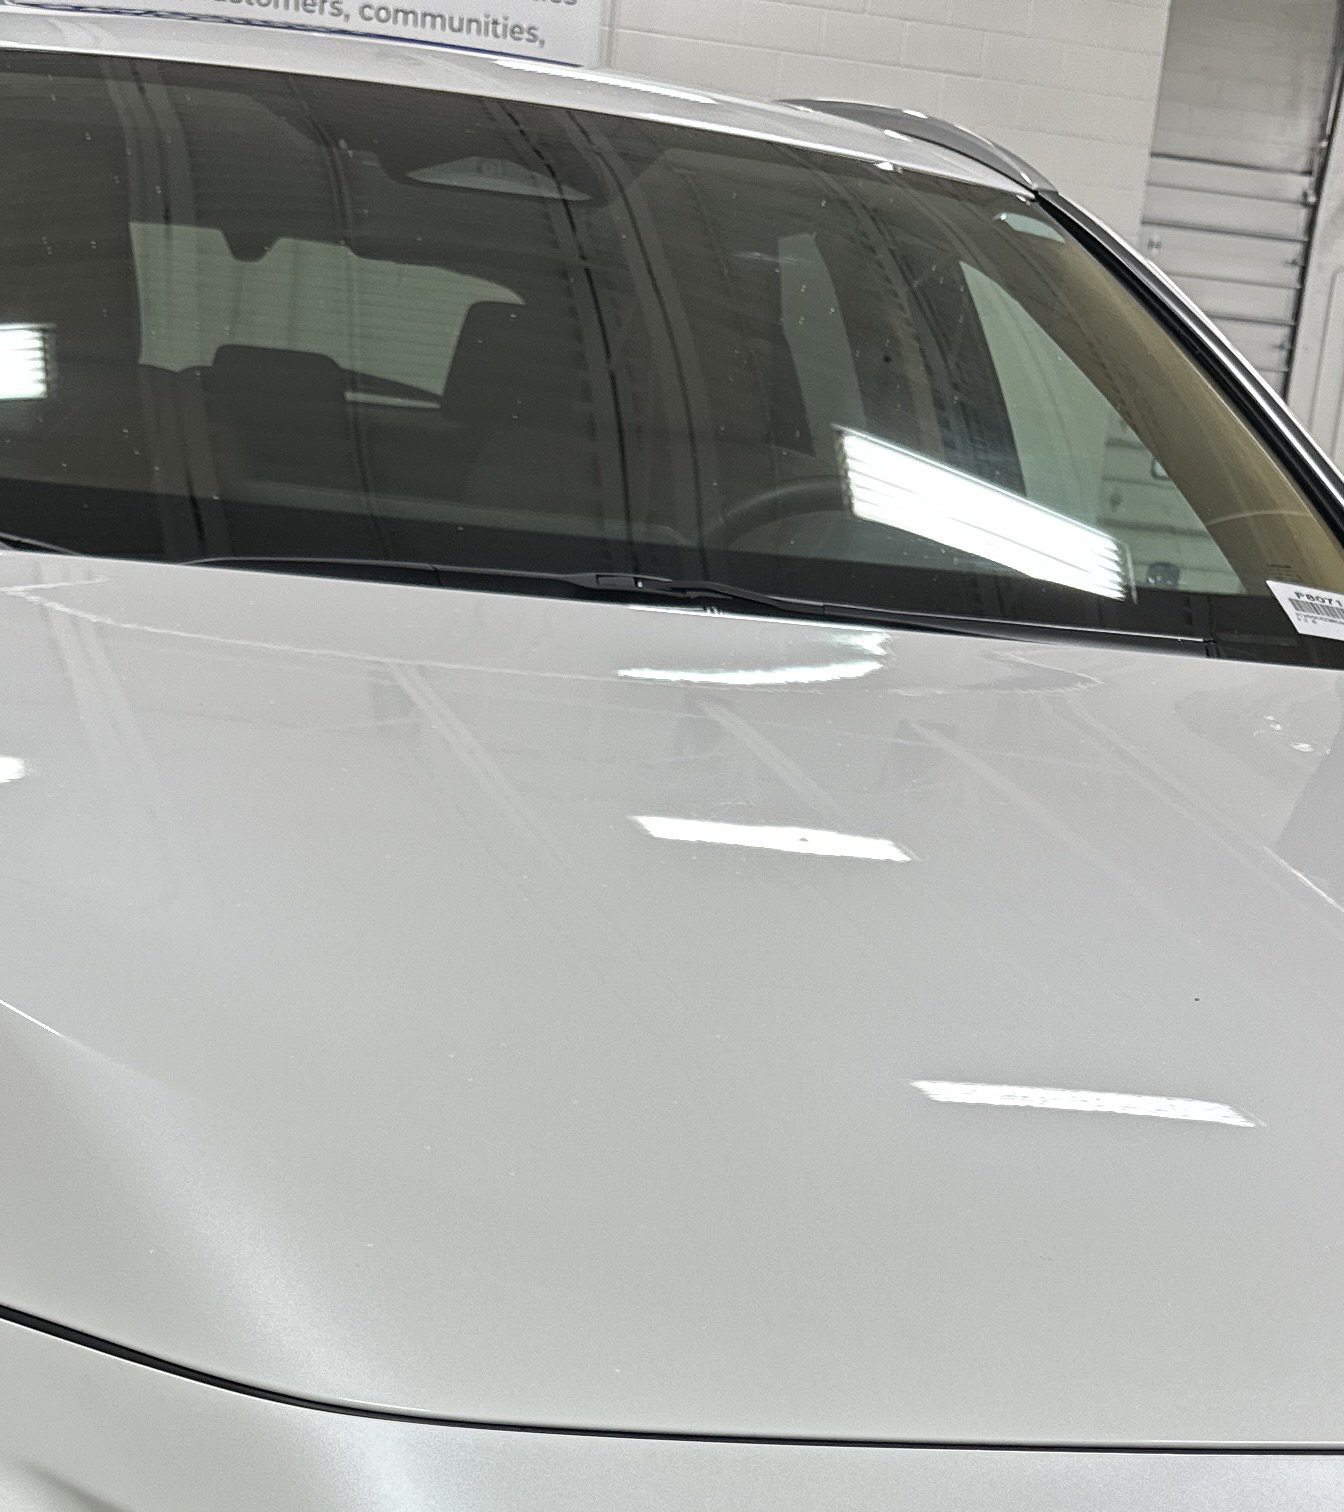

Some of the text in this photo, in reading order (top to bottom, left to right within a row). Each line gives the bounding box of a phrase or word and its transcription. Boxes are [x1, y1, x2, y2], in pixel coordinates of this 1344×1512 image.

[213, 0, 545, 48] mers, communities,
[1294, 591, 1343, 608] P8071
